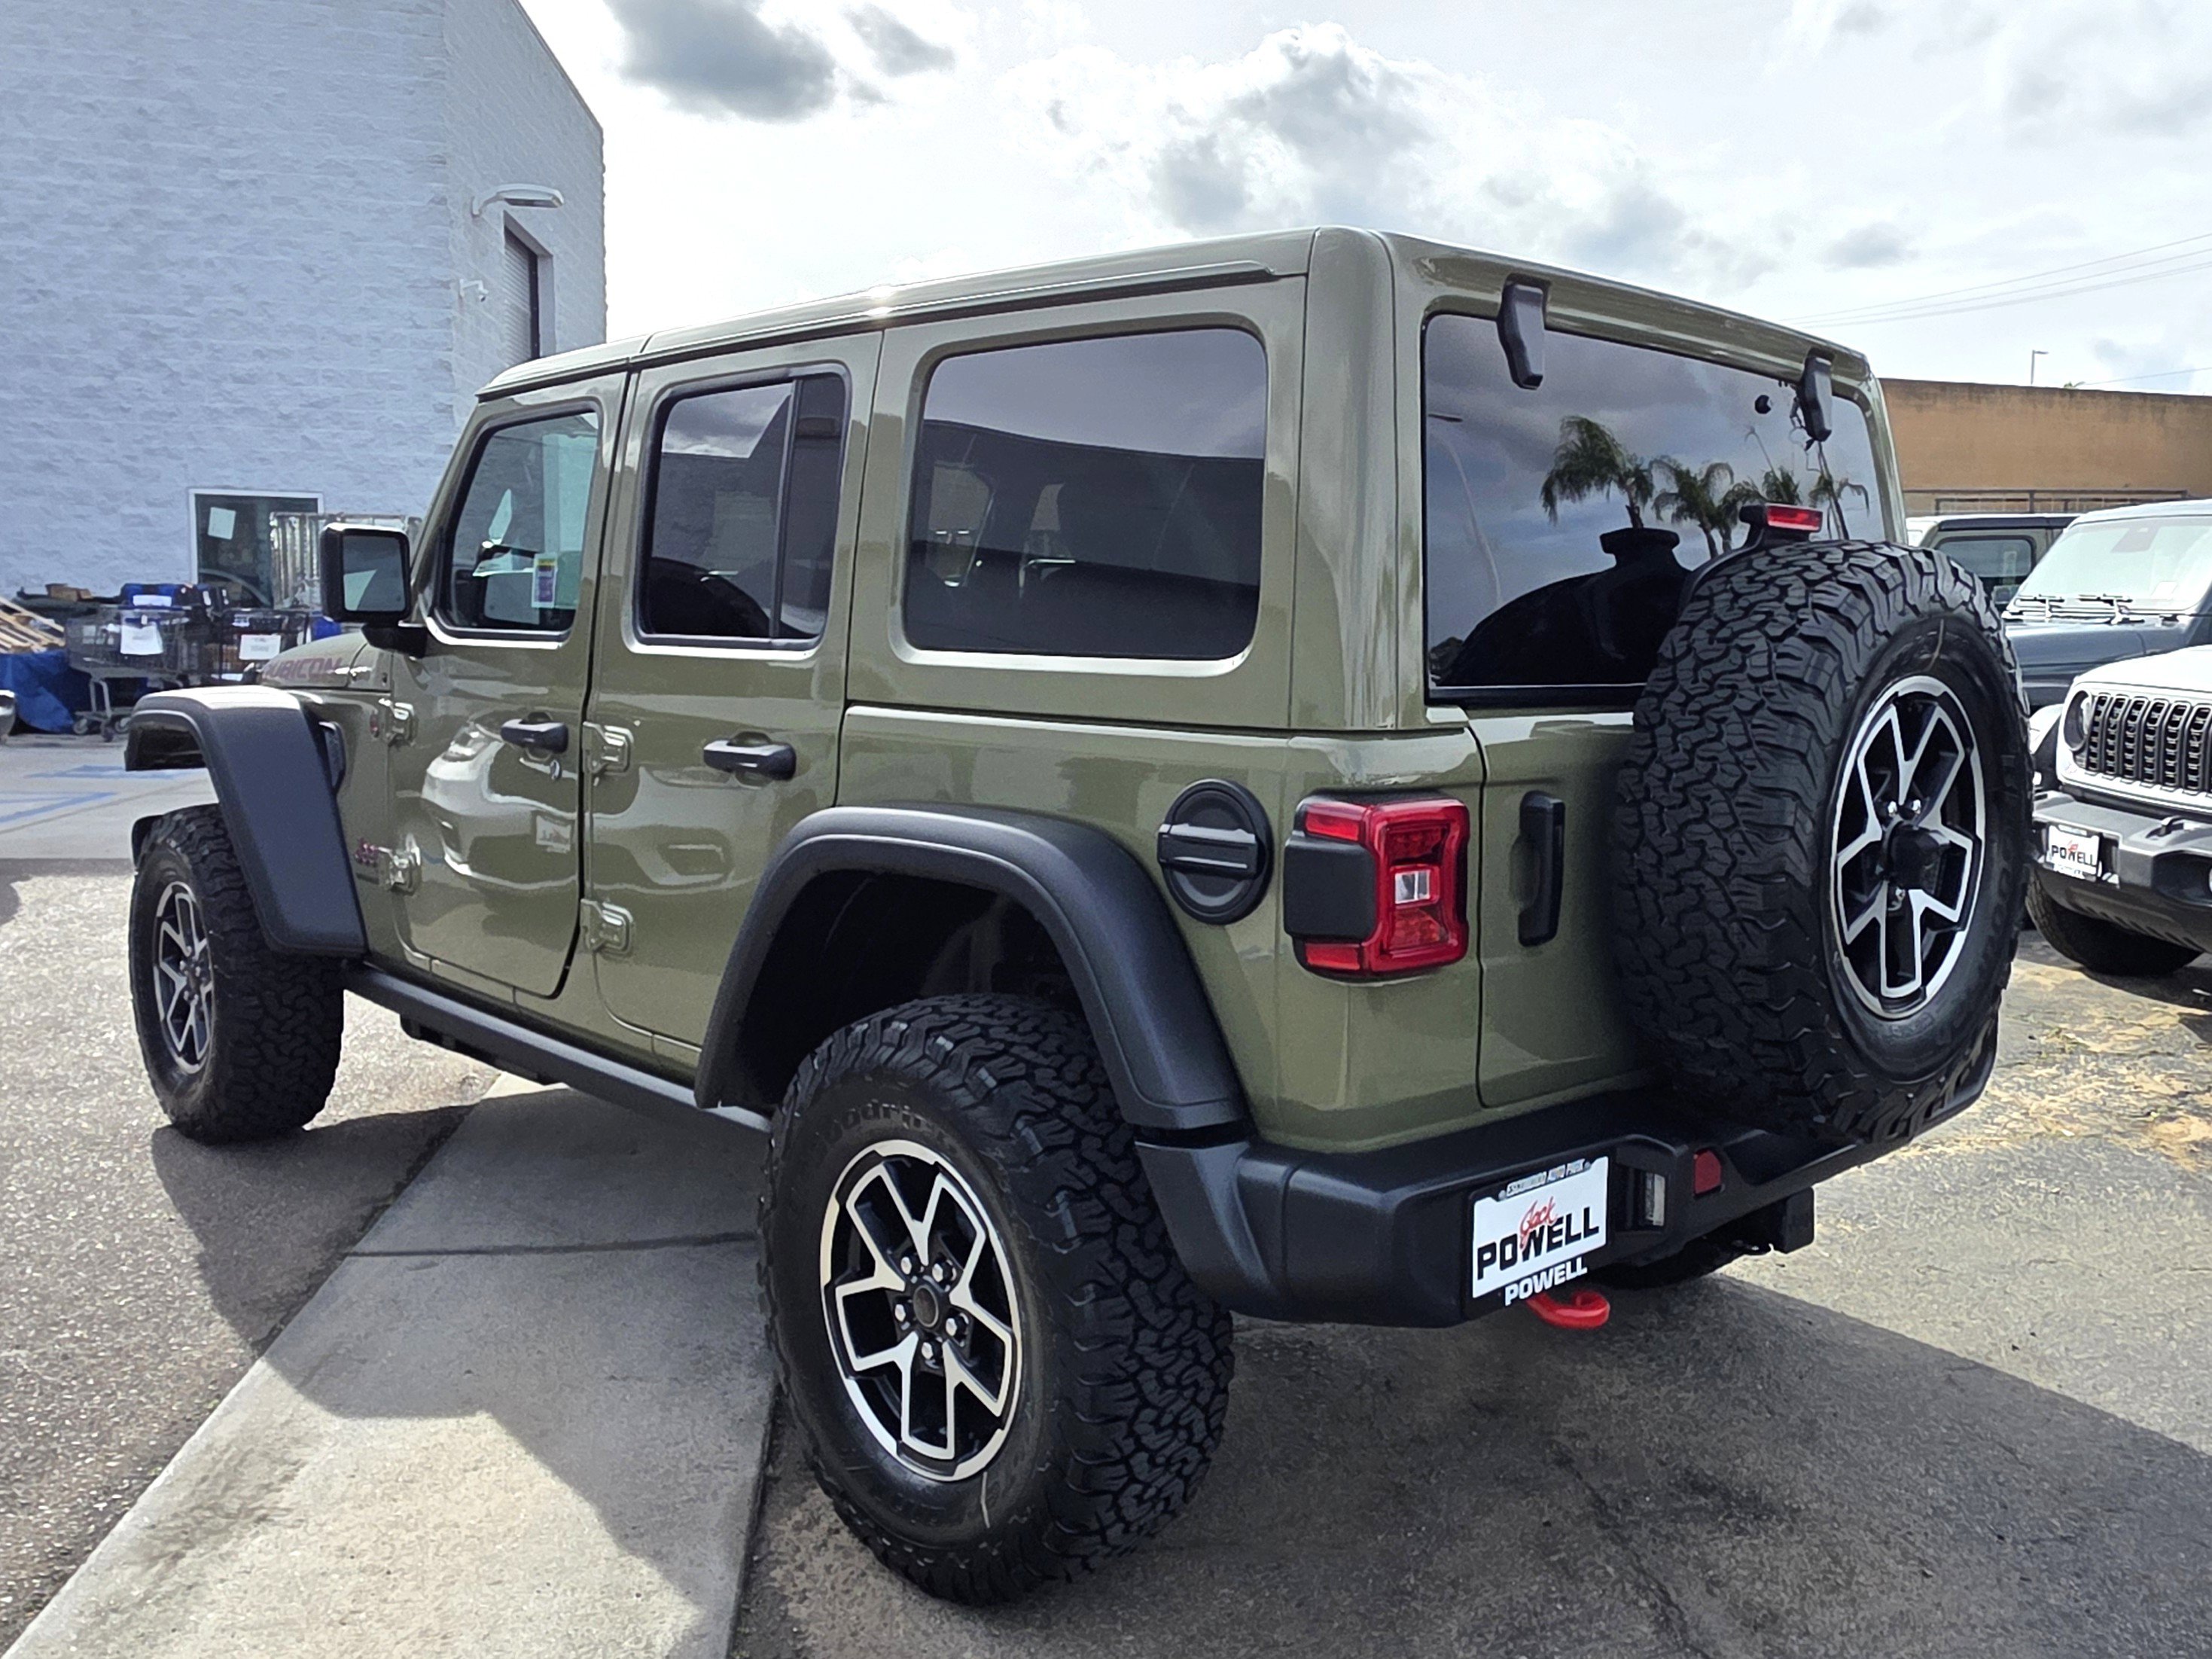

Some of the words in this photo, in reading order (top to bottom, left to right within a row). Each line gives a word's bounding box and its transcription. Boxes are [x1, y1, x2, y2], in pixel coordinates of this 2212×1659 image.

[1477, 1206, 1600, 1281] POWELL
[1519, 1196, 1557, 1249] Jack
[1505, 1256, 1588, 1307] POWELL
